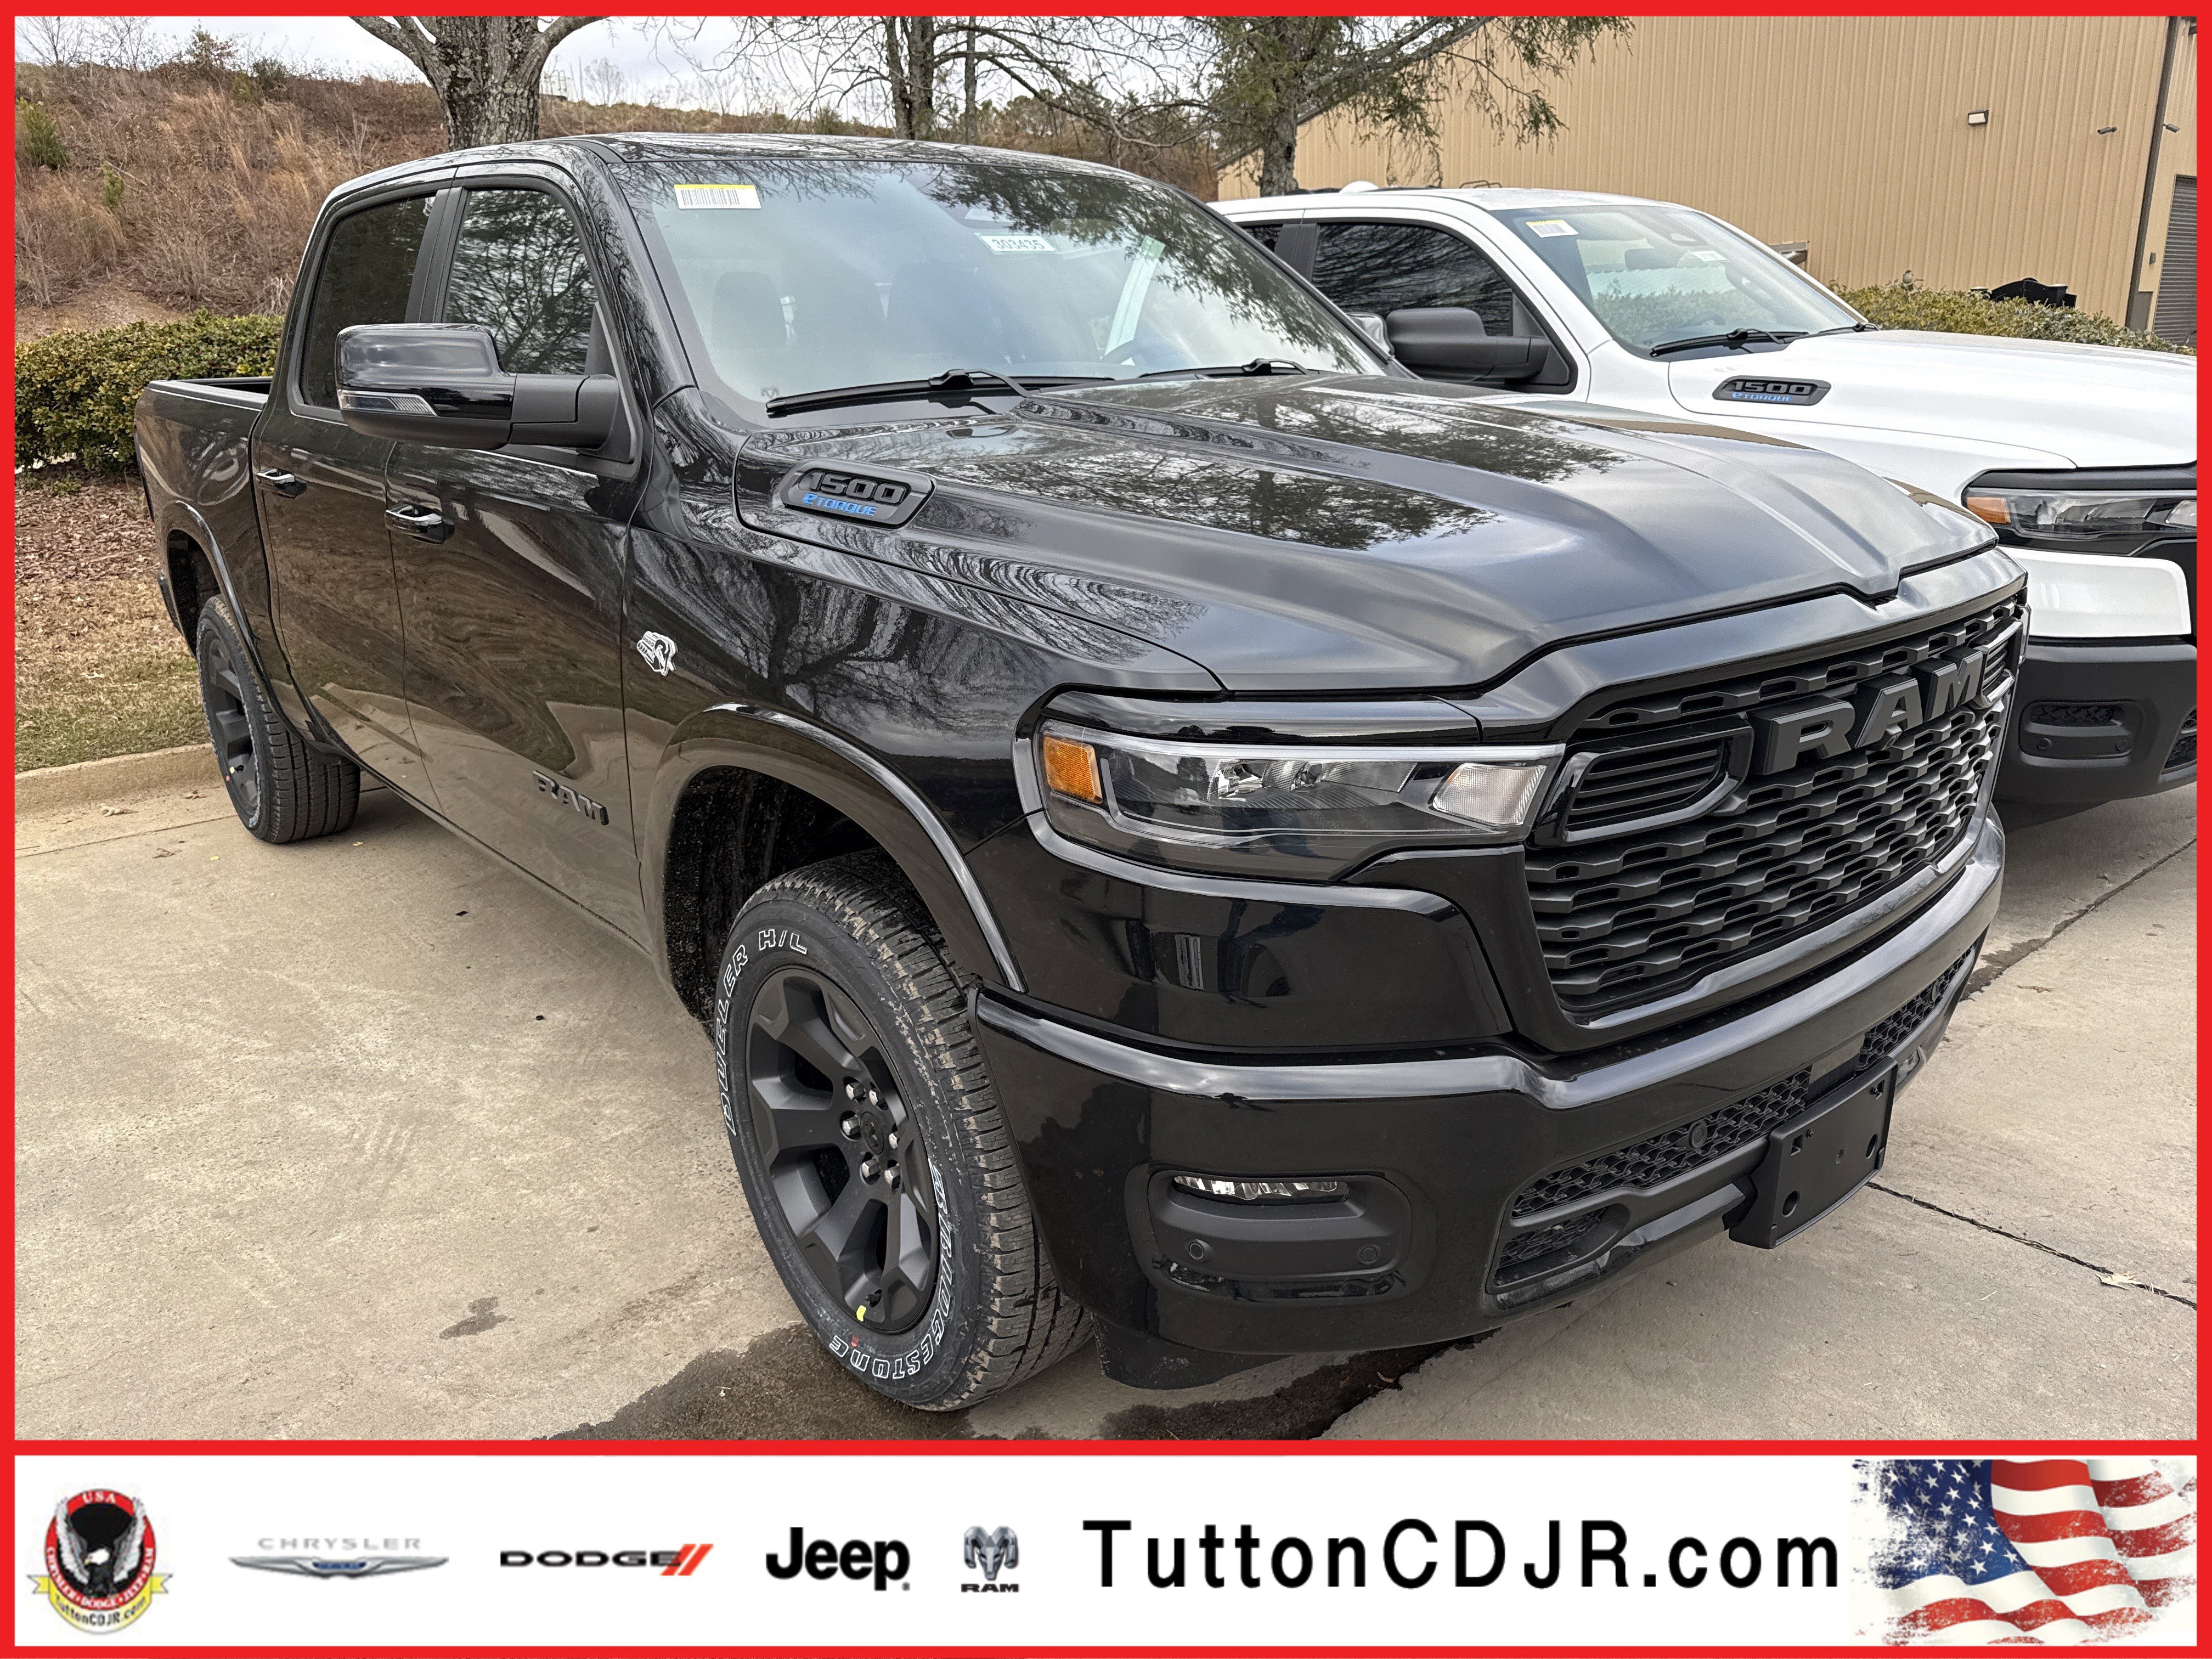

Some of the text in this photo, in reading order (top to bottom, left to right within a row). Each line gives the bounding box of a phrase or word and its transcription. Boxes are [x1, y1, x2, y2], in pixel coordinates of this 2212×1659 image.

[992, 239, 1045, 249] 303435
[1733, 381, 1812, 395] 1500
[802, 493, 878, 516] eTORQUE
[809, 472, 906, 505] 1500
[1742, 649, 1983, 775] RAM
[533, 770, 609, 826] RAM
[716, 929, 807, 1136] DUELER H/L
[829, 1158, 952, 1379] BRIDGESTONE
